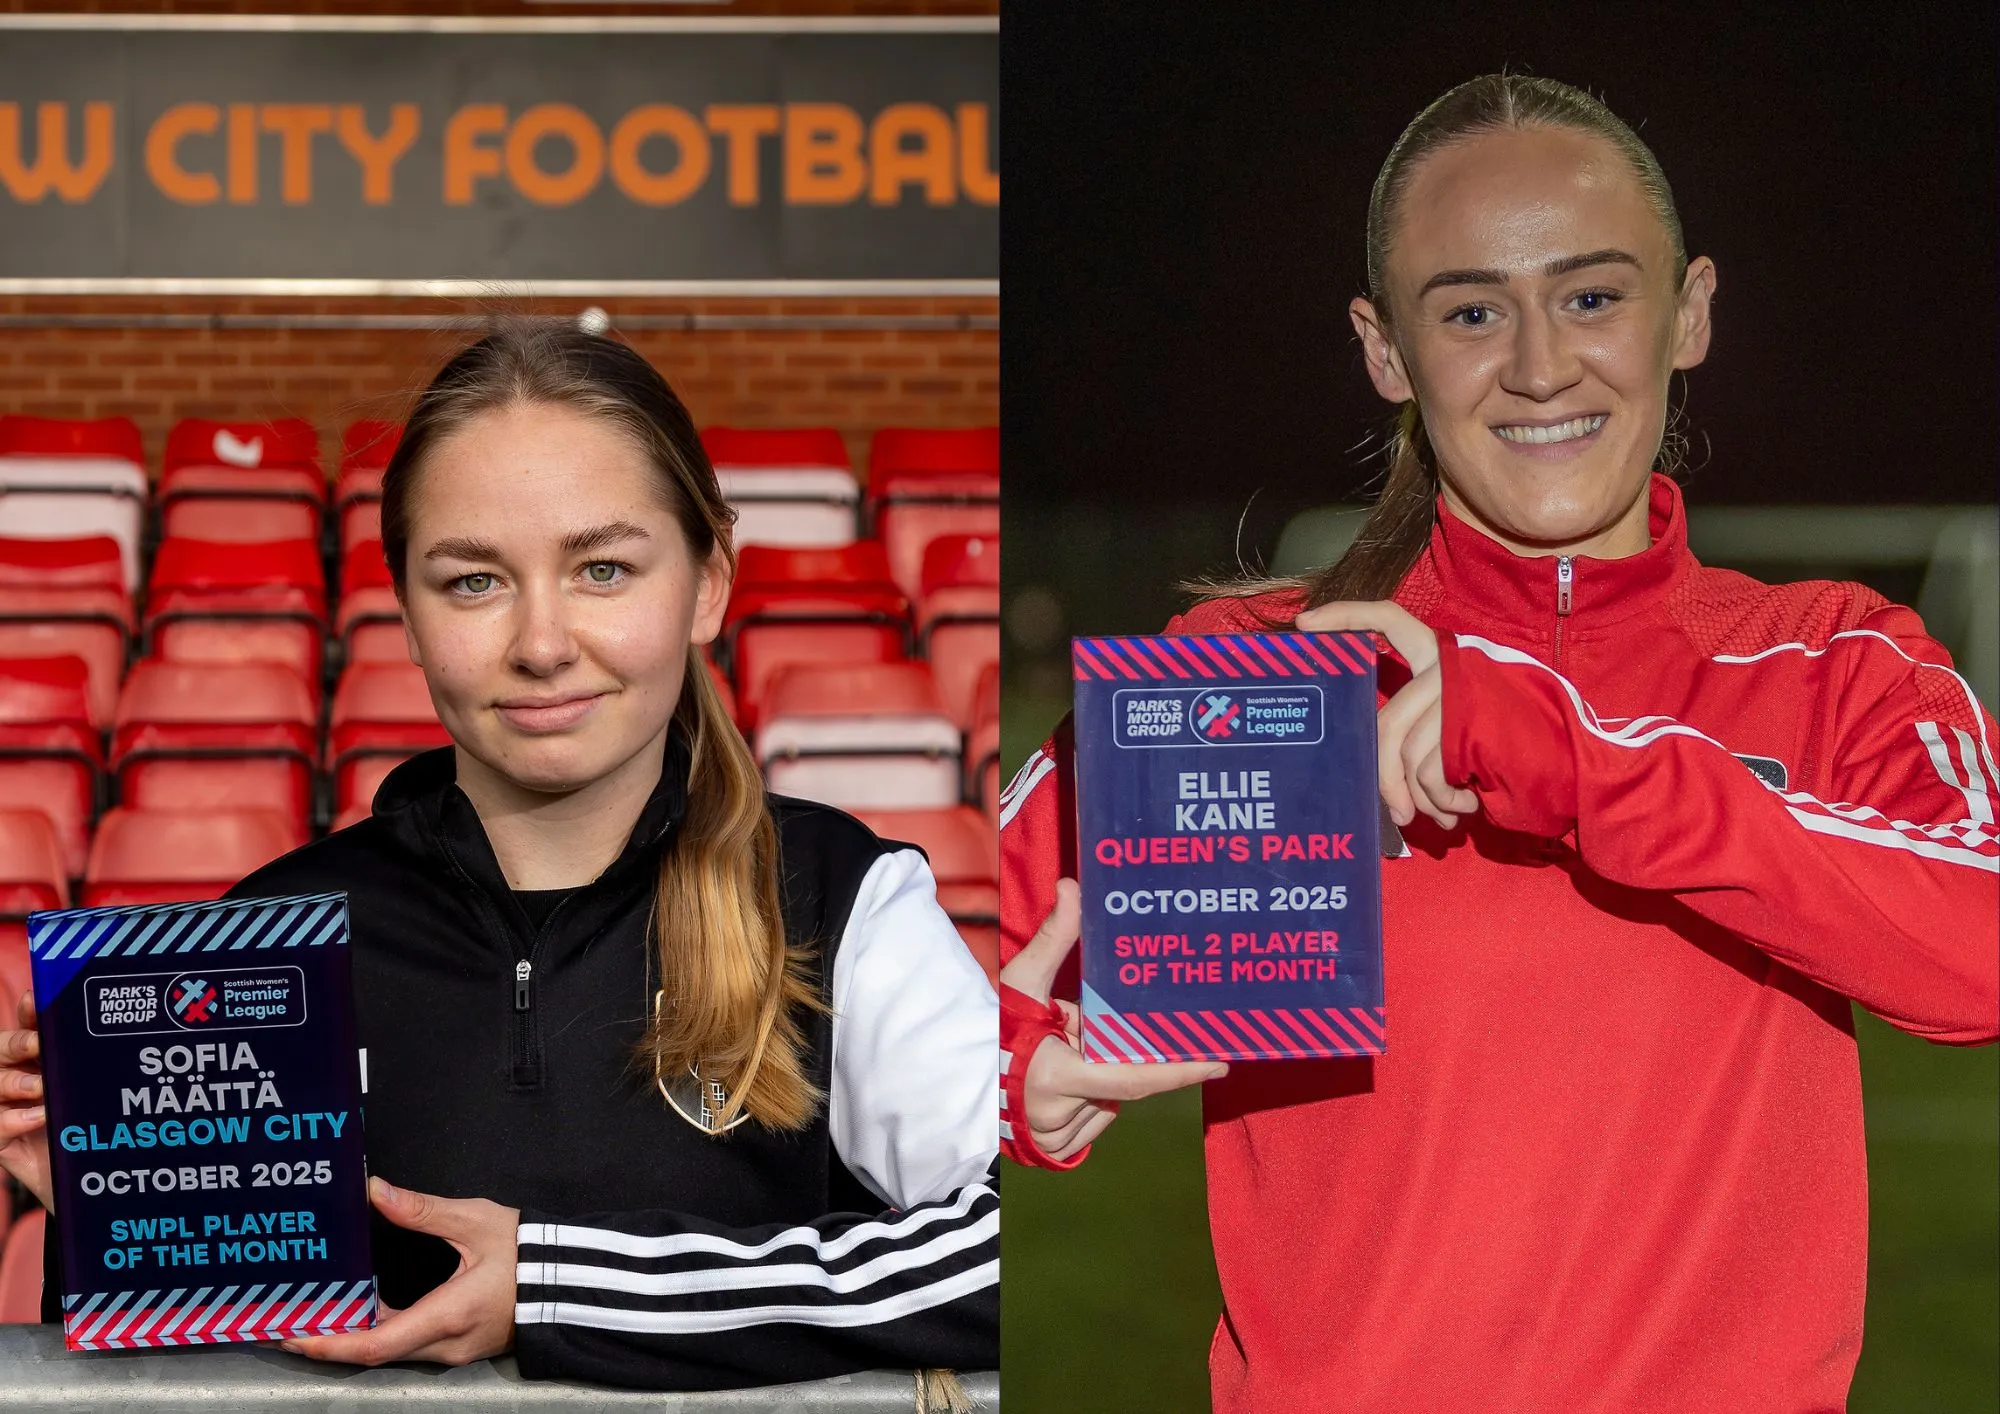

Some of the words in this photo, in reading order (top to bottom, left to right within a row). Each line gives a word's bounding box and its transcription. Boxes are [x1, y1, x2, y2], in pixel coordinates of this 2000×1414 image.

[145, 103, 420, 205] CITY
[443, 102, 999, 206] FOOTBAL
[1126, 699, 1182, 713] PARK'S
[1246, 704, 1309, 718] Premier
[1277, 696, 1309, 704] Women's
[1126, 711, 1182, 724] MOTOR
[1126, 723, 1181, 737] GROUP
[1246, 721, 1305, 737] League
[1178, 771, 1271, 799] ELLIE
[1175, 802, 1275, 831] KANE
[1095, 835, 1250, 868] QUEEN'S
[1262, 833, 1355, 861] PARK
[1104, 887, 1260, 915] OCTOBER
[1269, 886, 1348, 911] 2025
[1114, 933, 1196, 958] SWPL
[1204, 932, 1222, 955] 2
[1231, 930, 1339, 954] PLAYER
[223, 979, 255, 988] Scottish
[255, 977, 289, 986] Women's
[1119, 962, 1158, 985] OF
[1167, 961, 1222, 984] THE
[1231, 959, 1336, 982] MONTH
[99, 985, 156, 1000] PARK'S
[99, 997, 158, 1012] MOTOR
[223, 986, 290, 1002] Premier
[100, 1010, 157, 1025] GROUP
[225, 1004, 287, 1020] League
[139, 1041, 259, 1075] SOFIA
[121, 1070, 283, 1116] MÄÄTTÄ
[60, 1115, 251, 1151] GLASGOW
[264, 1111, 348, 1141] CITY
[80, 1164, 241, 1196] OCTOBER
[251, 1160, 333, 1187] 2025
[111, 1215, 195, 1242] SWPL
[203, 1211, 317, 1237] PLAYER
[103, 1247, 144, 1270] OF
[152, 1244, 209, 1268] THE
[219, 1238, 328, 1265] MONTH
